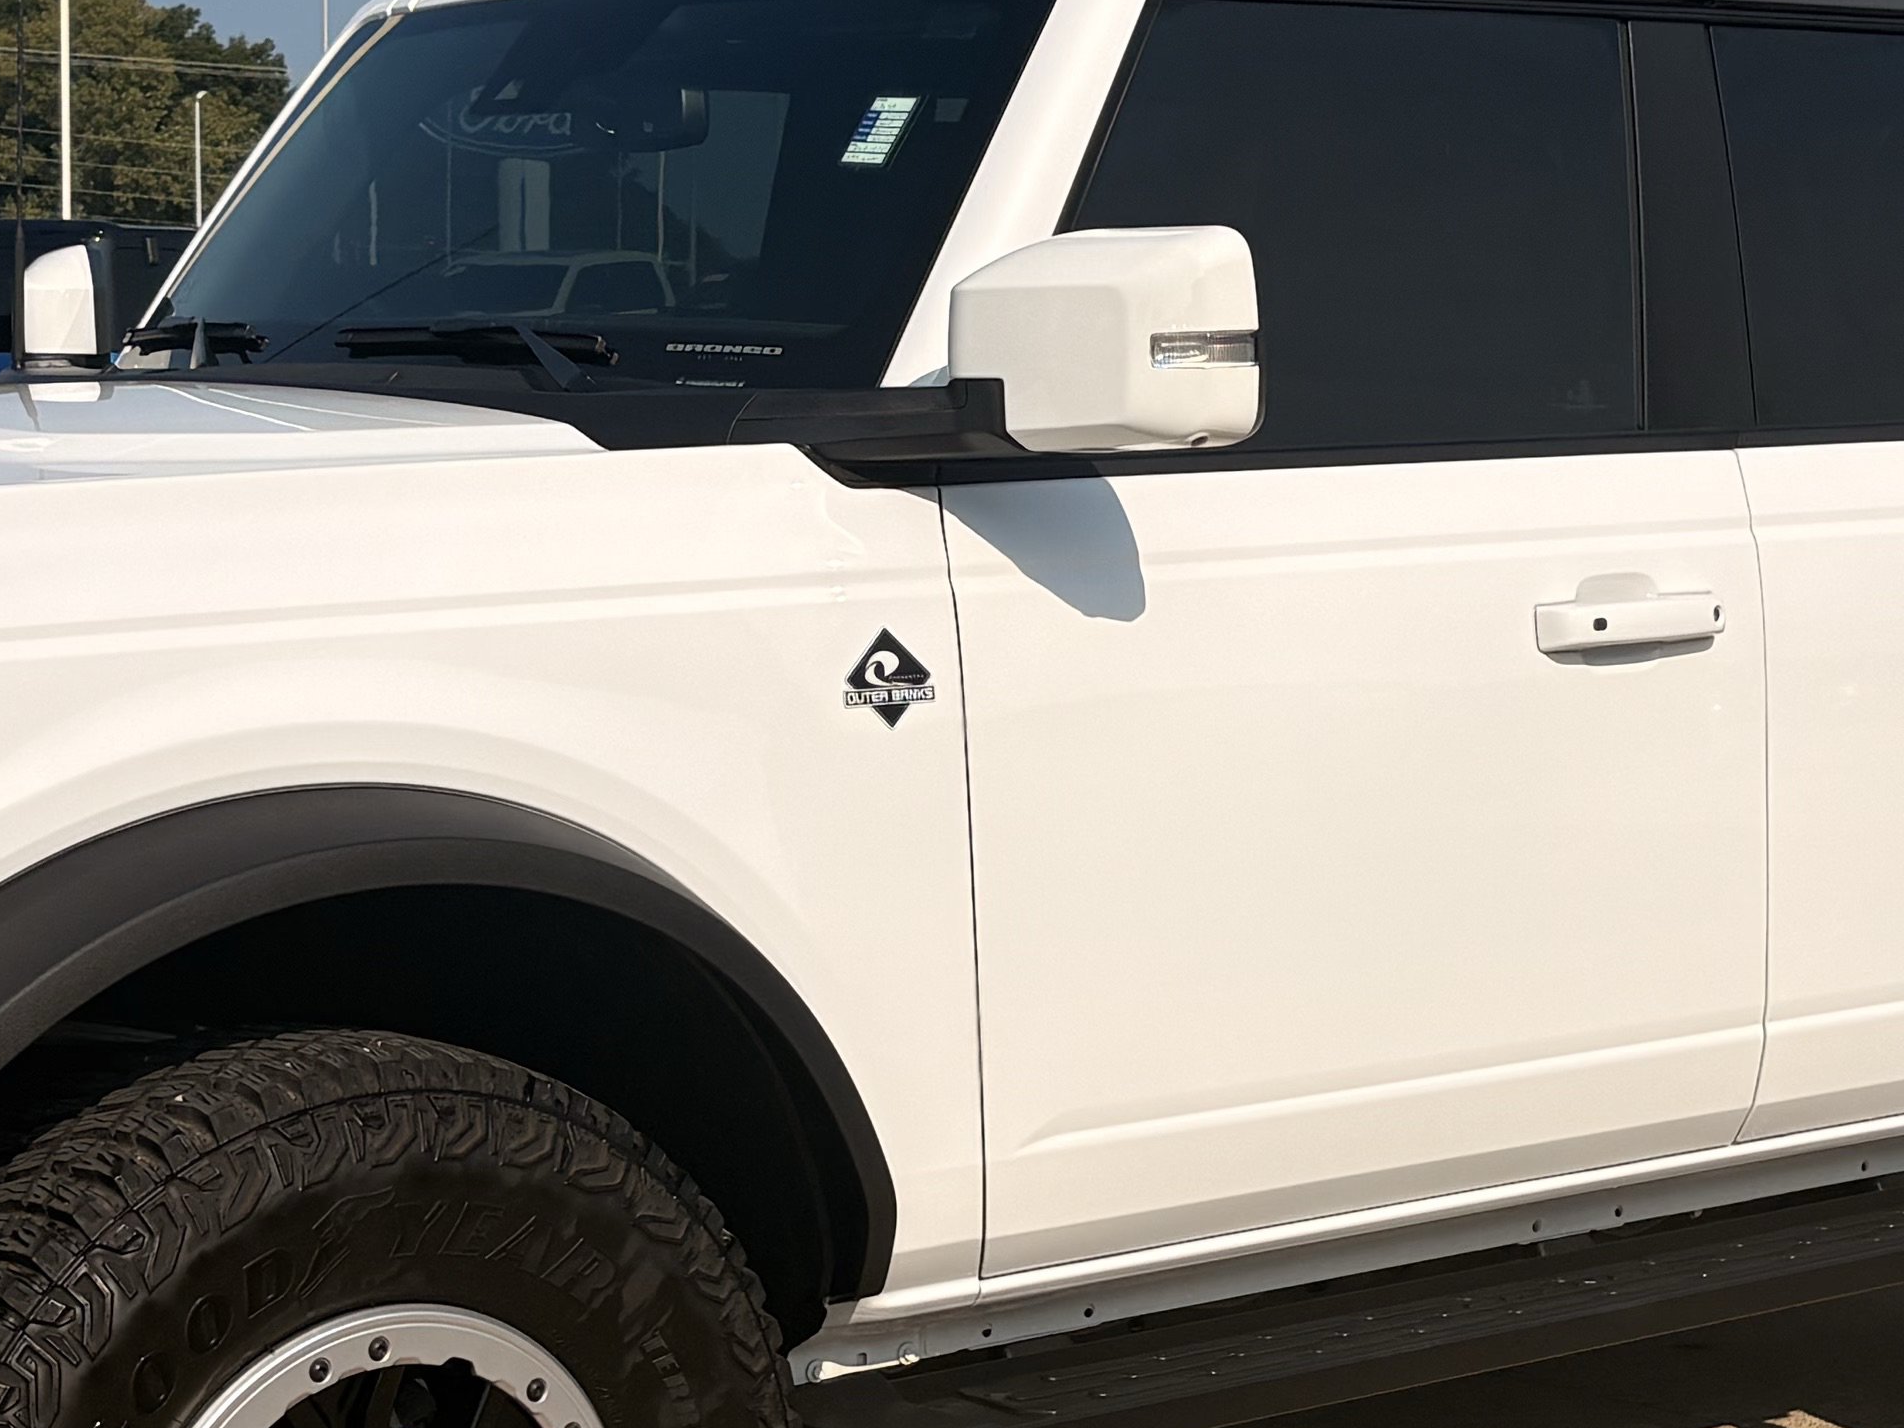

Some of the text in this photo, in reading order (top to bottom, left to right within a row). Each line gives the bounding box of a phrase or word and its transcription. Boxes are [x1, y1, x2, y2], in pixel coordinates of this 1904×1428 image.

[666, 343, 784, 356] BRONCO
[847, 687, 934, 705] OUTER BANKS
